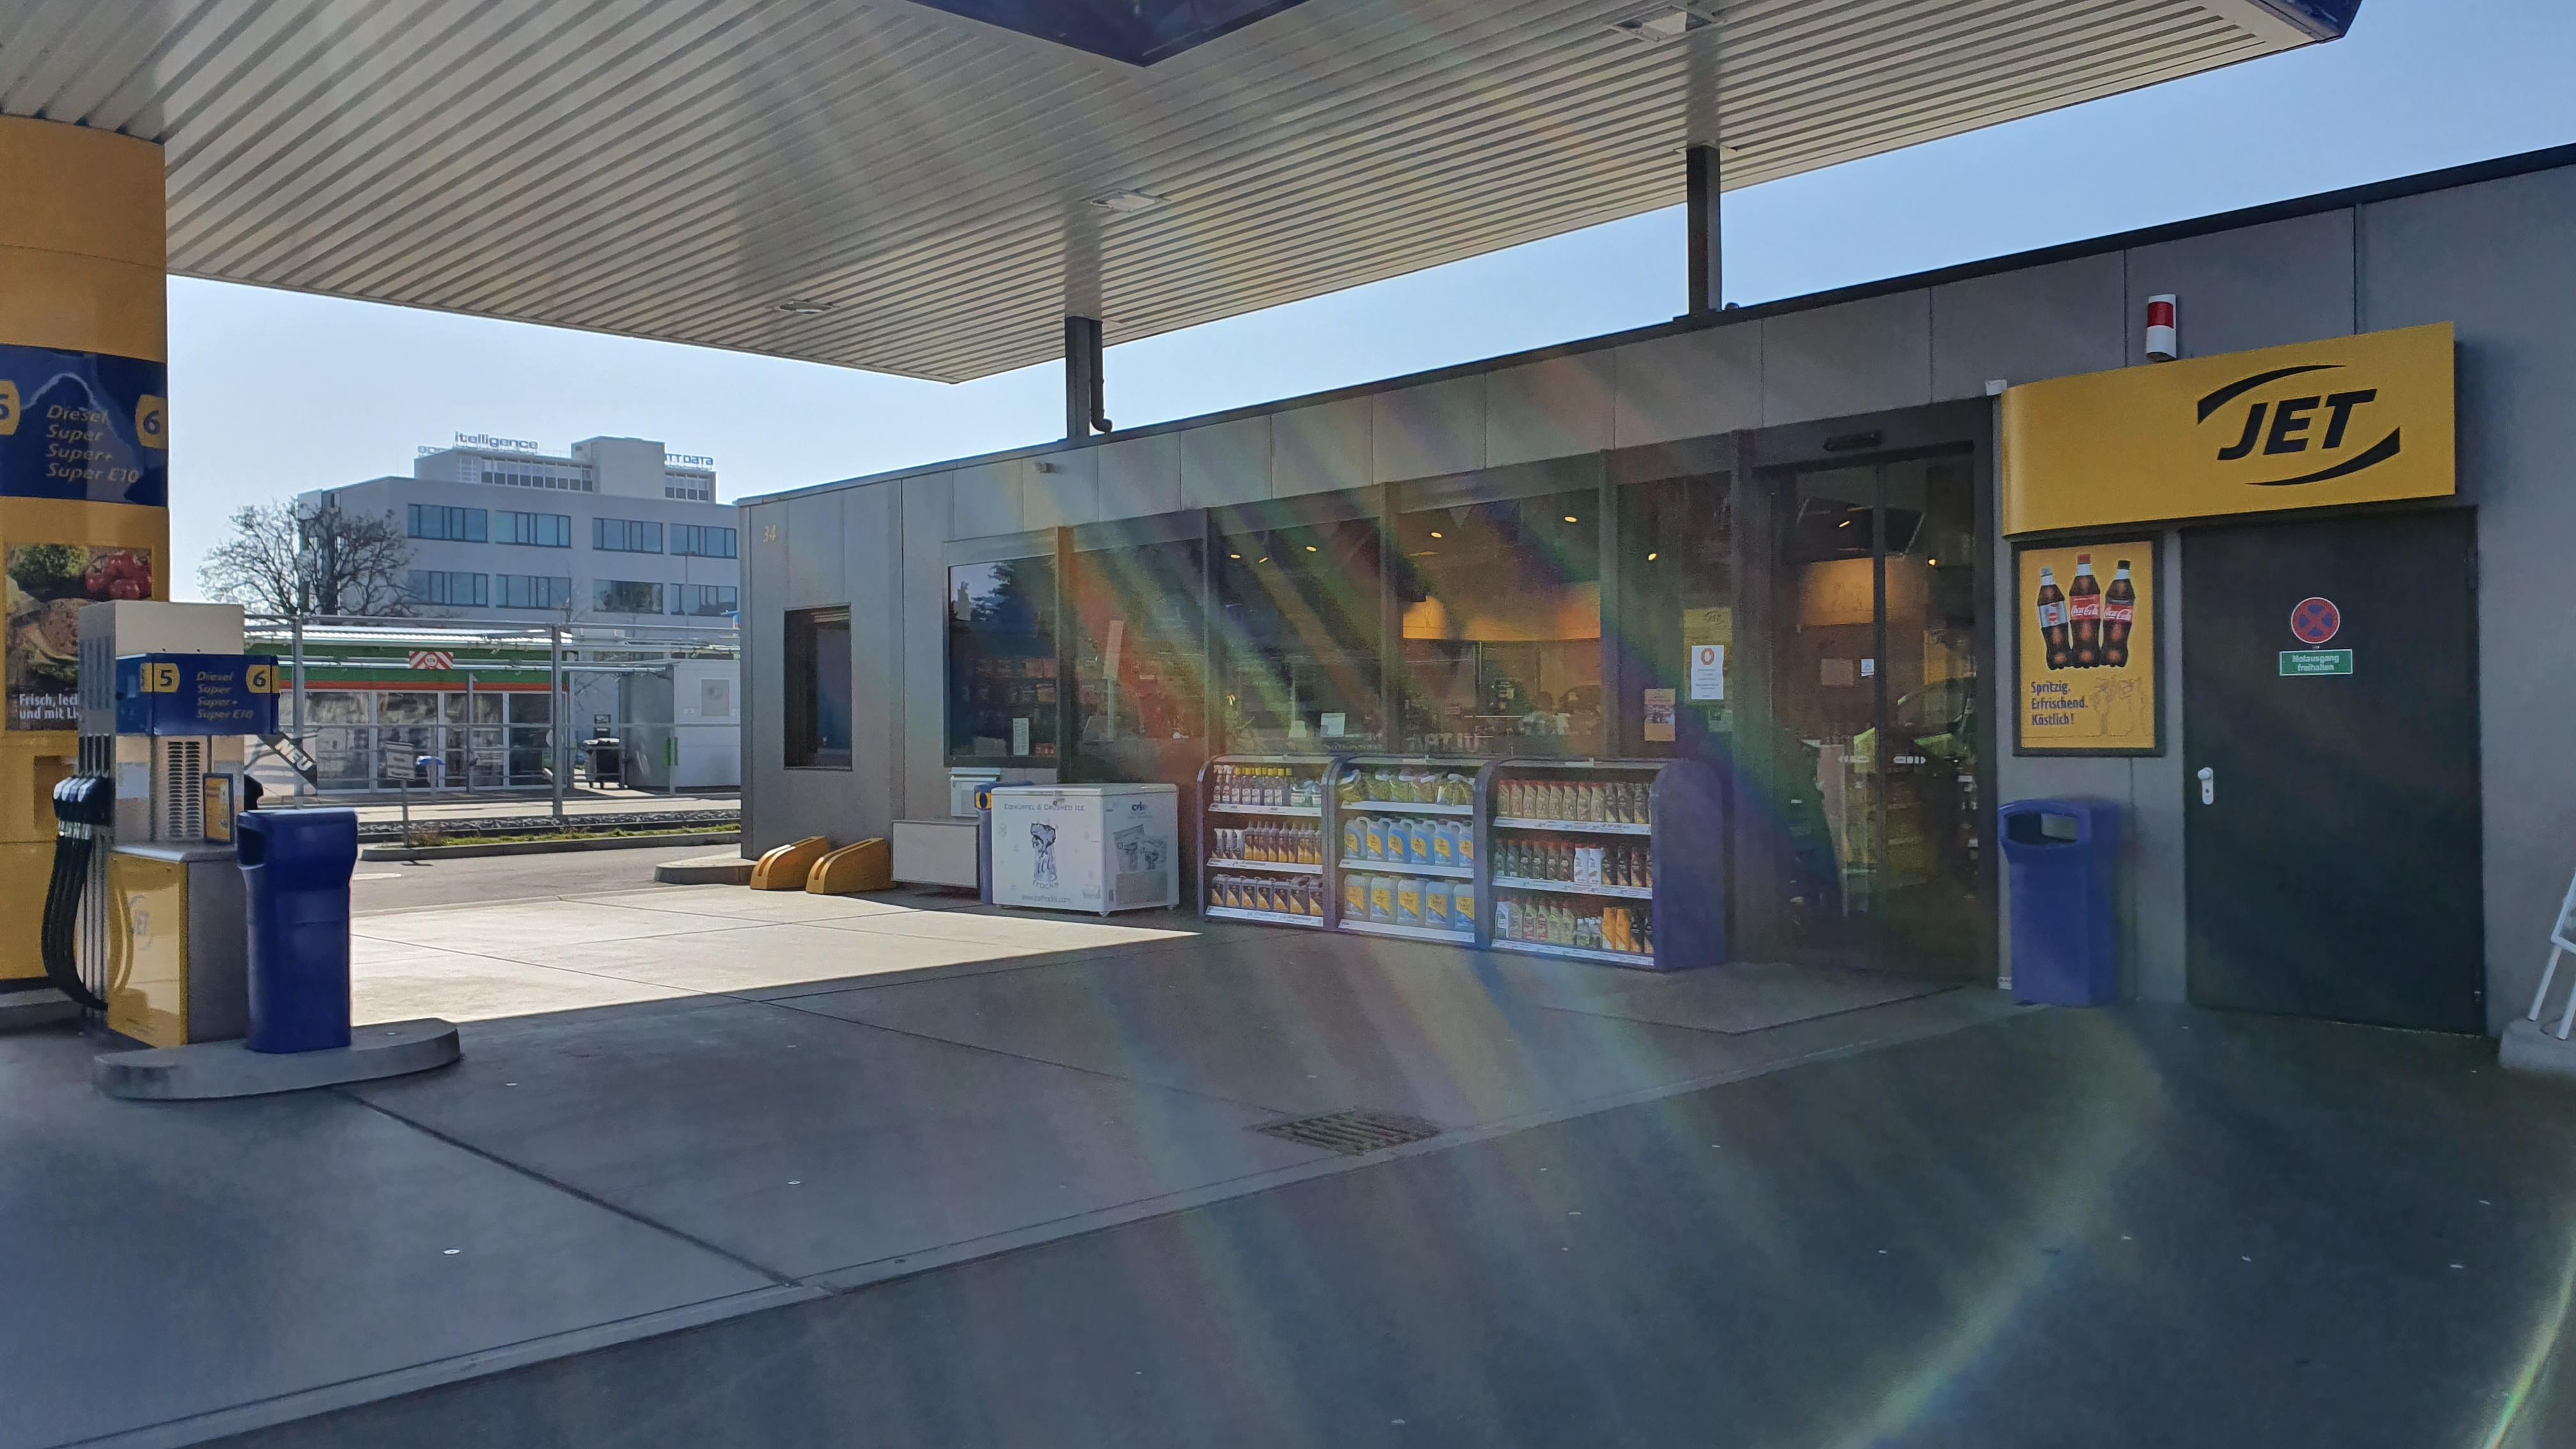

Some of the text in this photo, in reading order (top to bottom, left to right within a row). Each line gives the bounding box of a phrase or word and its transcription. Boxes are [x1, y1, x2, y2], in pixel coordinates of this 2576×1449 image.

[47, 405, 109, 424] Diesel
[143, 409, 160, 435] 6
[2217, 388, 2377, 461] JET
[46, 424, 105, 443] Super
[454, 431, 539, 450] itelligence
[46, 463, 139, 484] Super E10
[2292, 655, 2340, 663] Notausgang
[160, 670, 173, 687] 5
[196, 671, 234, 681] Diesel
[252, 671, 266, 687] 6
[196, 684, 231, 695] Super
[2031, 680, 2071, 695] Spritzig.
[19, 693, 56, 707] Frisch,
[2031, 695, 2089, 710] Erfrischend.
[19, 708, 42, 719] und
[44, 707, 64, 719] mit
[196, 709, 254, 721] Super E10
[275, 738, 313, 771] NEU
